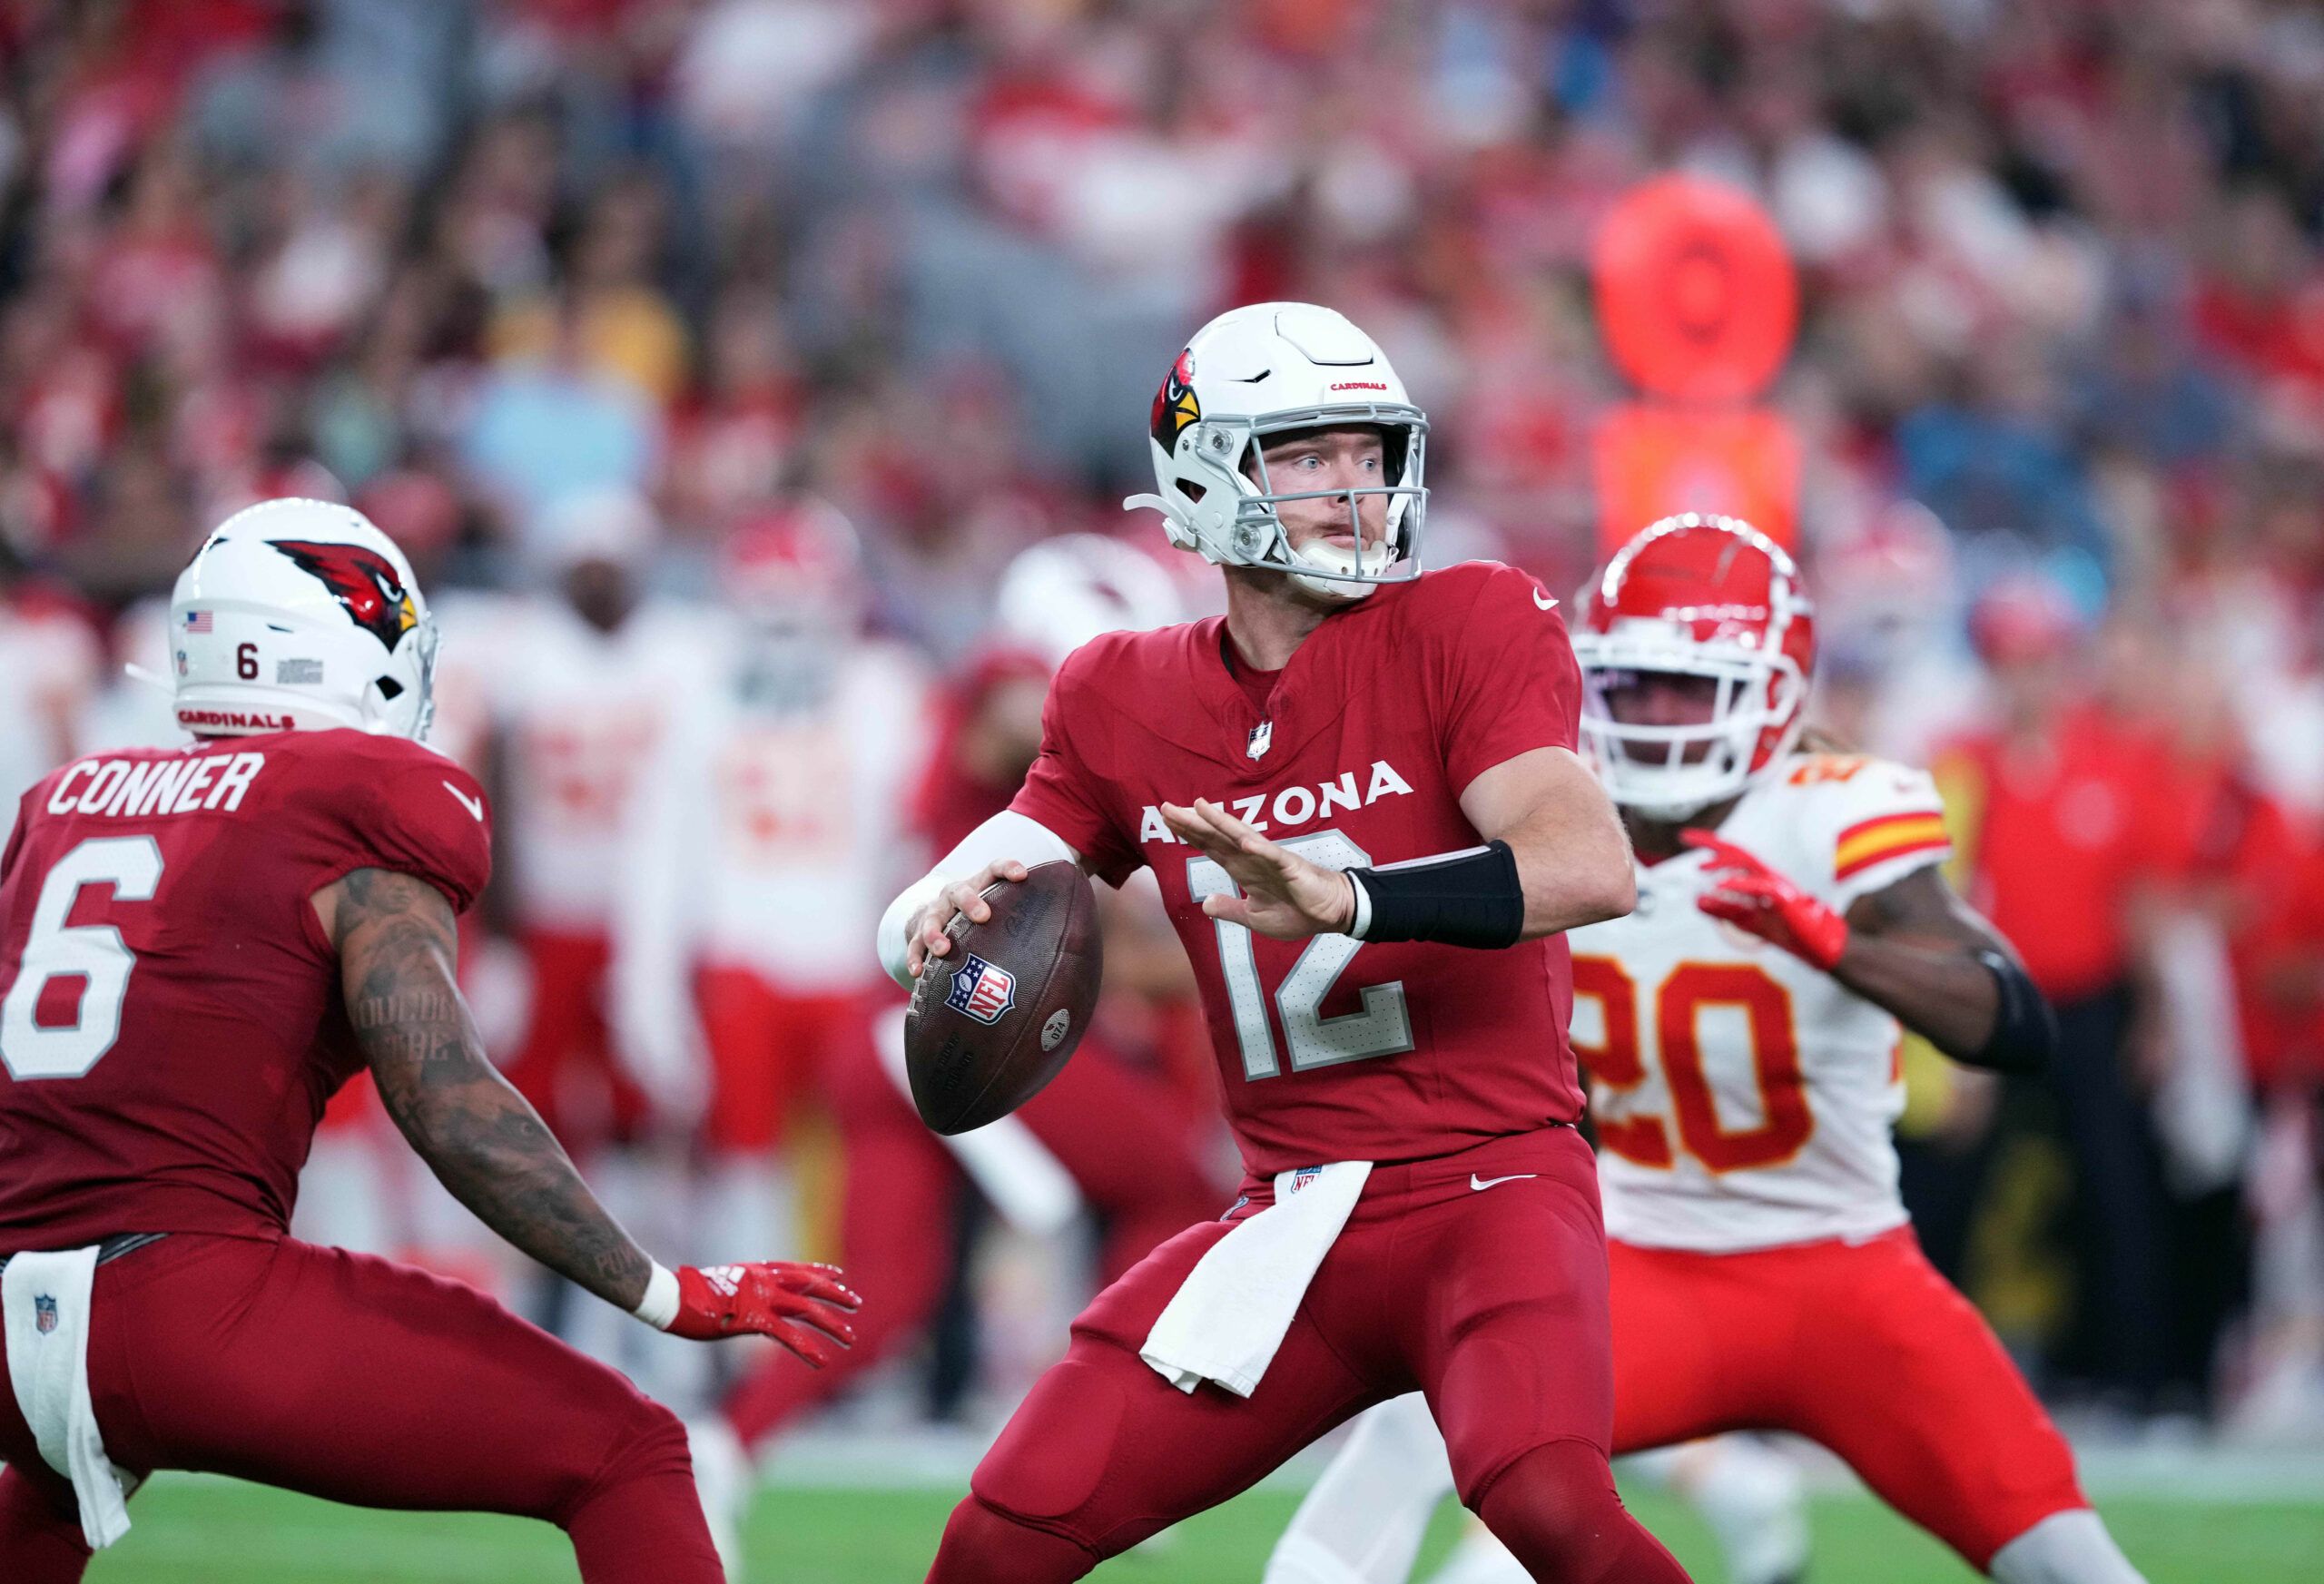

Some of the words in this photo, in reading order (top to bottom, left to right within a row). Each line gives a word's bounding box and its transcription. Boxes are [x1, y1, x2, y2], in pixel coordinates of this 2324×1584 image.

[1330, 382, 1387, 390] CARDINALS
[237, 643, 259, 680] 6
[178, 711, 295, 729] CARDINALS
[47, 753, 265, 817] CONNER
[1140, 760, 1414, 845] AZONA
[0, 834, 165, 1081] 6
[1186, 828, 1415, 1082] 12
[968, 973, 1009, 1019] NFL
[1570, 953, 1816, 1177] 20
[1294, 1175, 1315, 1191] NF
